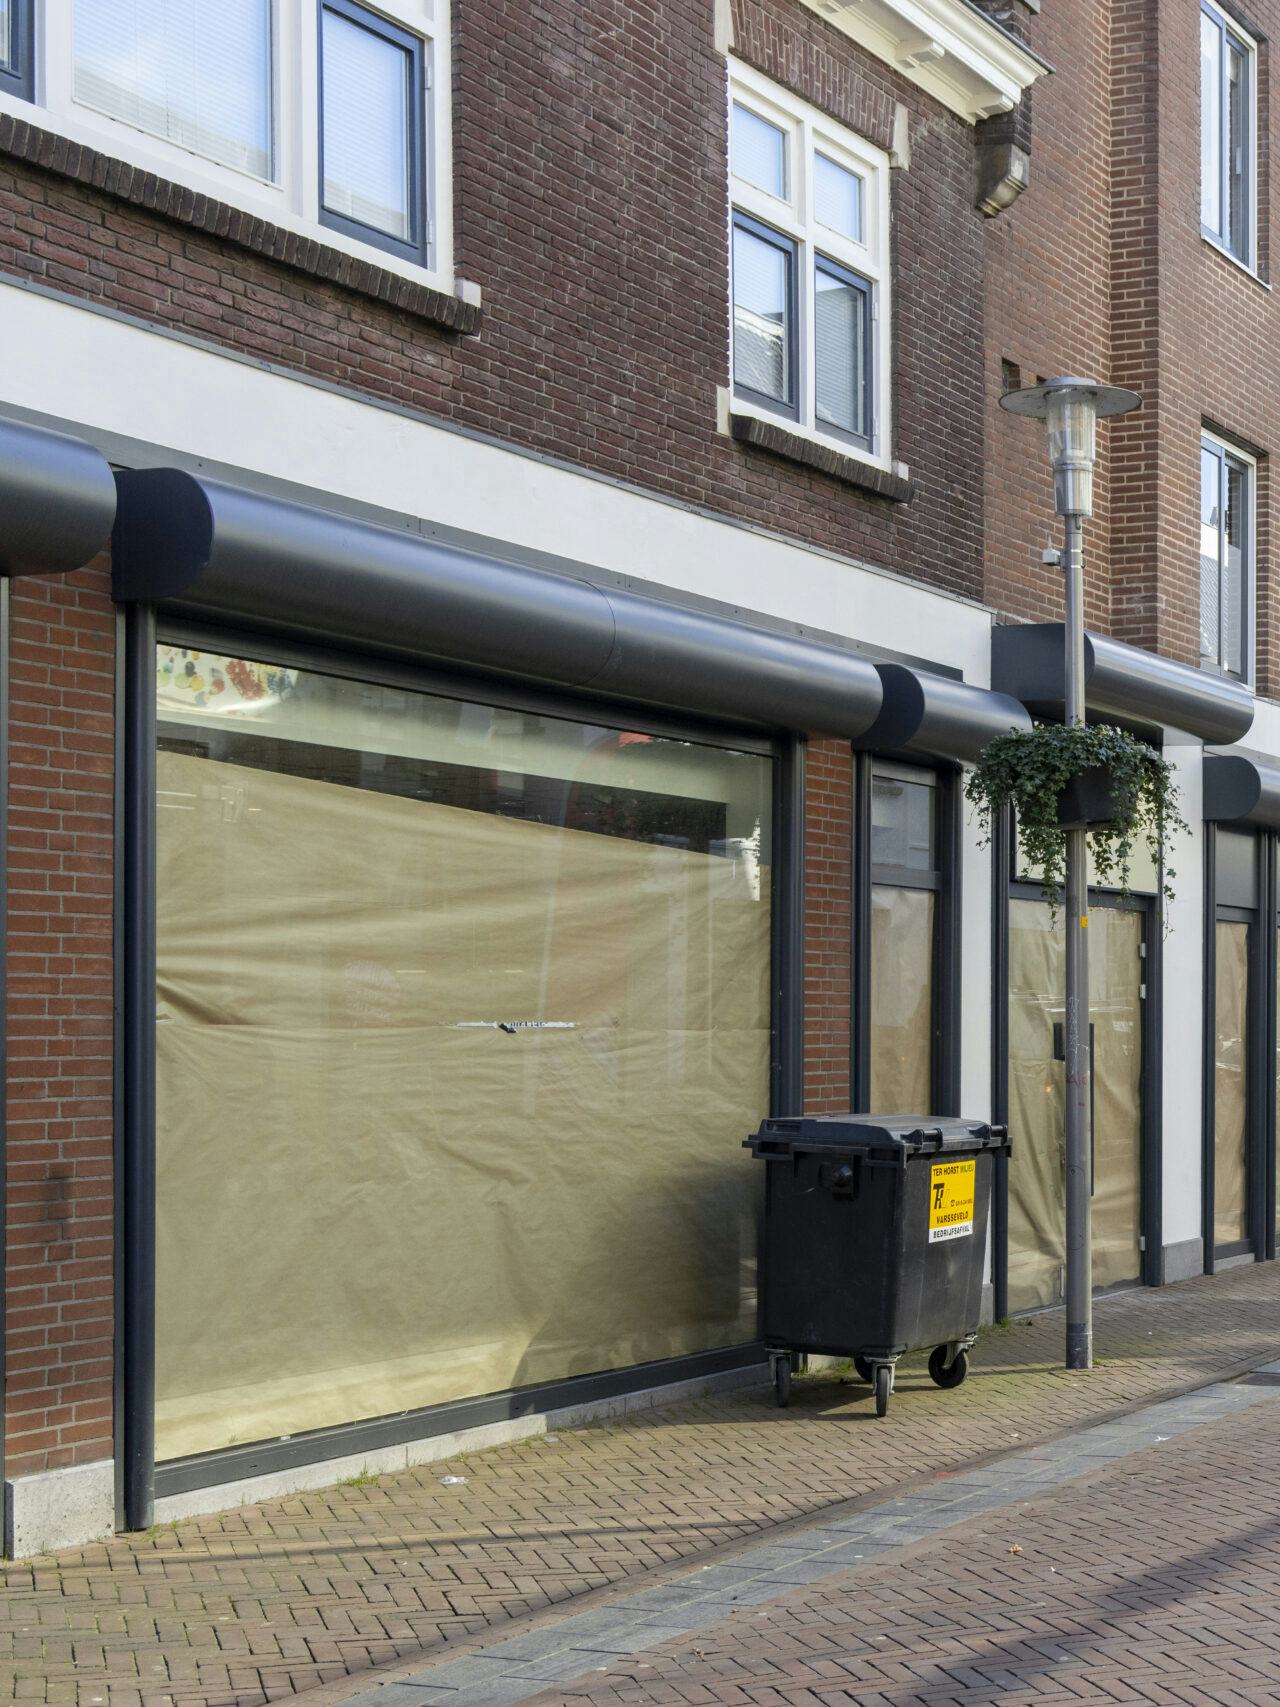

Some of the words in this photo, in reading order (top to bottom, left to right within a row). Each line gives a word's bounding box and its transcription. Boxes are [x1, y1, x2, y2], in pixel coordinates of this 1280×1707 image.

[933, 1168, 943, 1177] TER
[943, 1166, 960, 1176] HORST
[936, 1211, 969, 1224] VARSSEVELD
